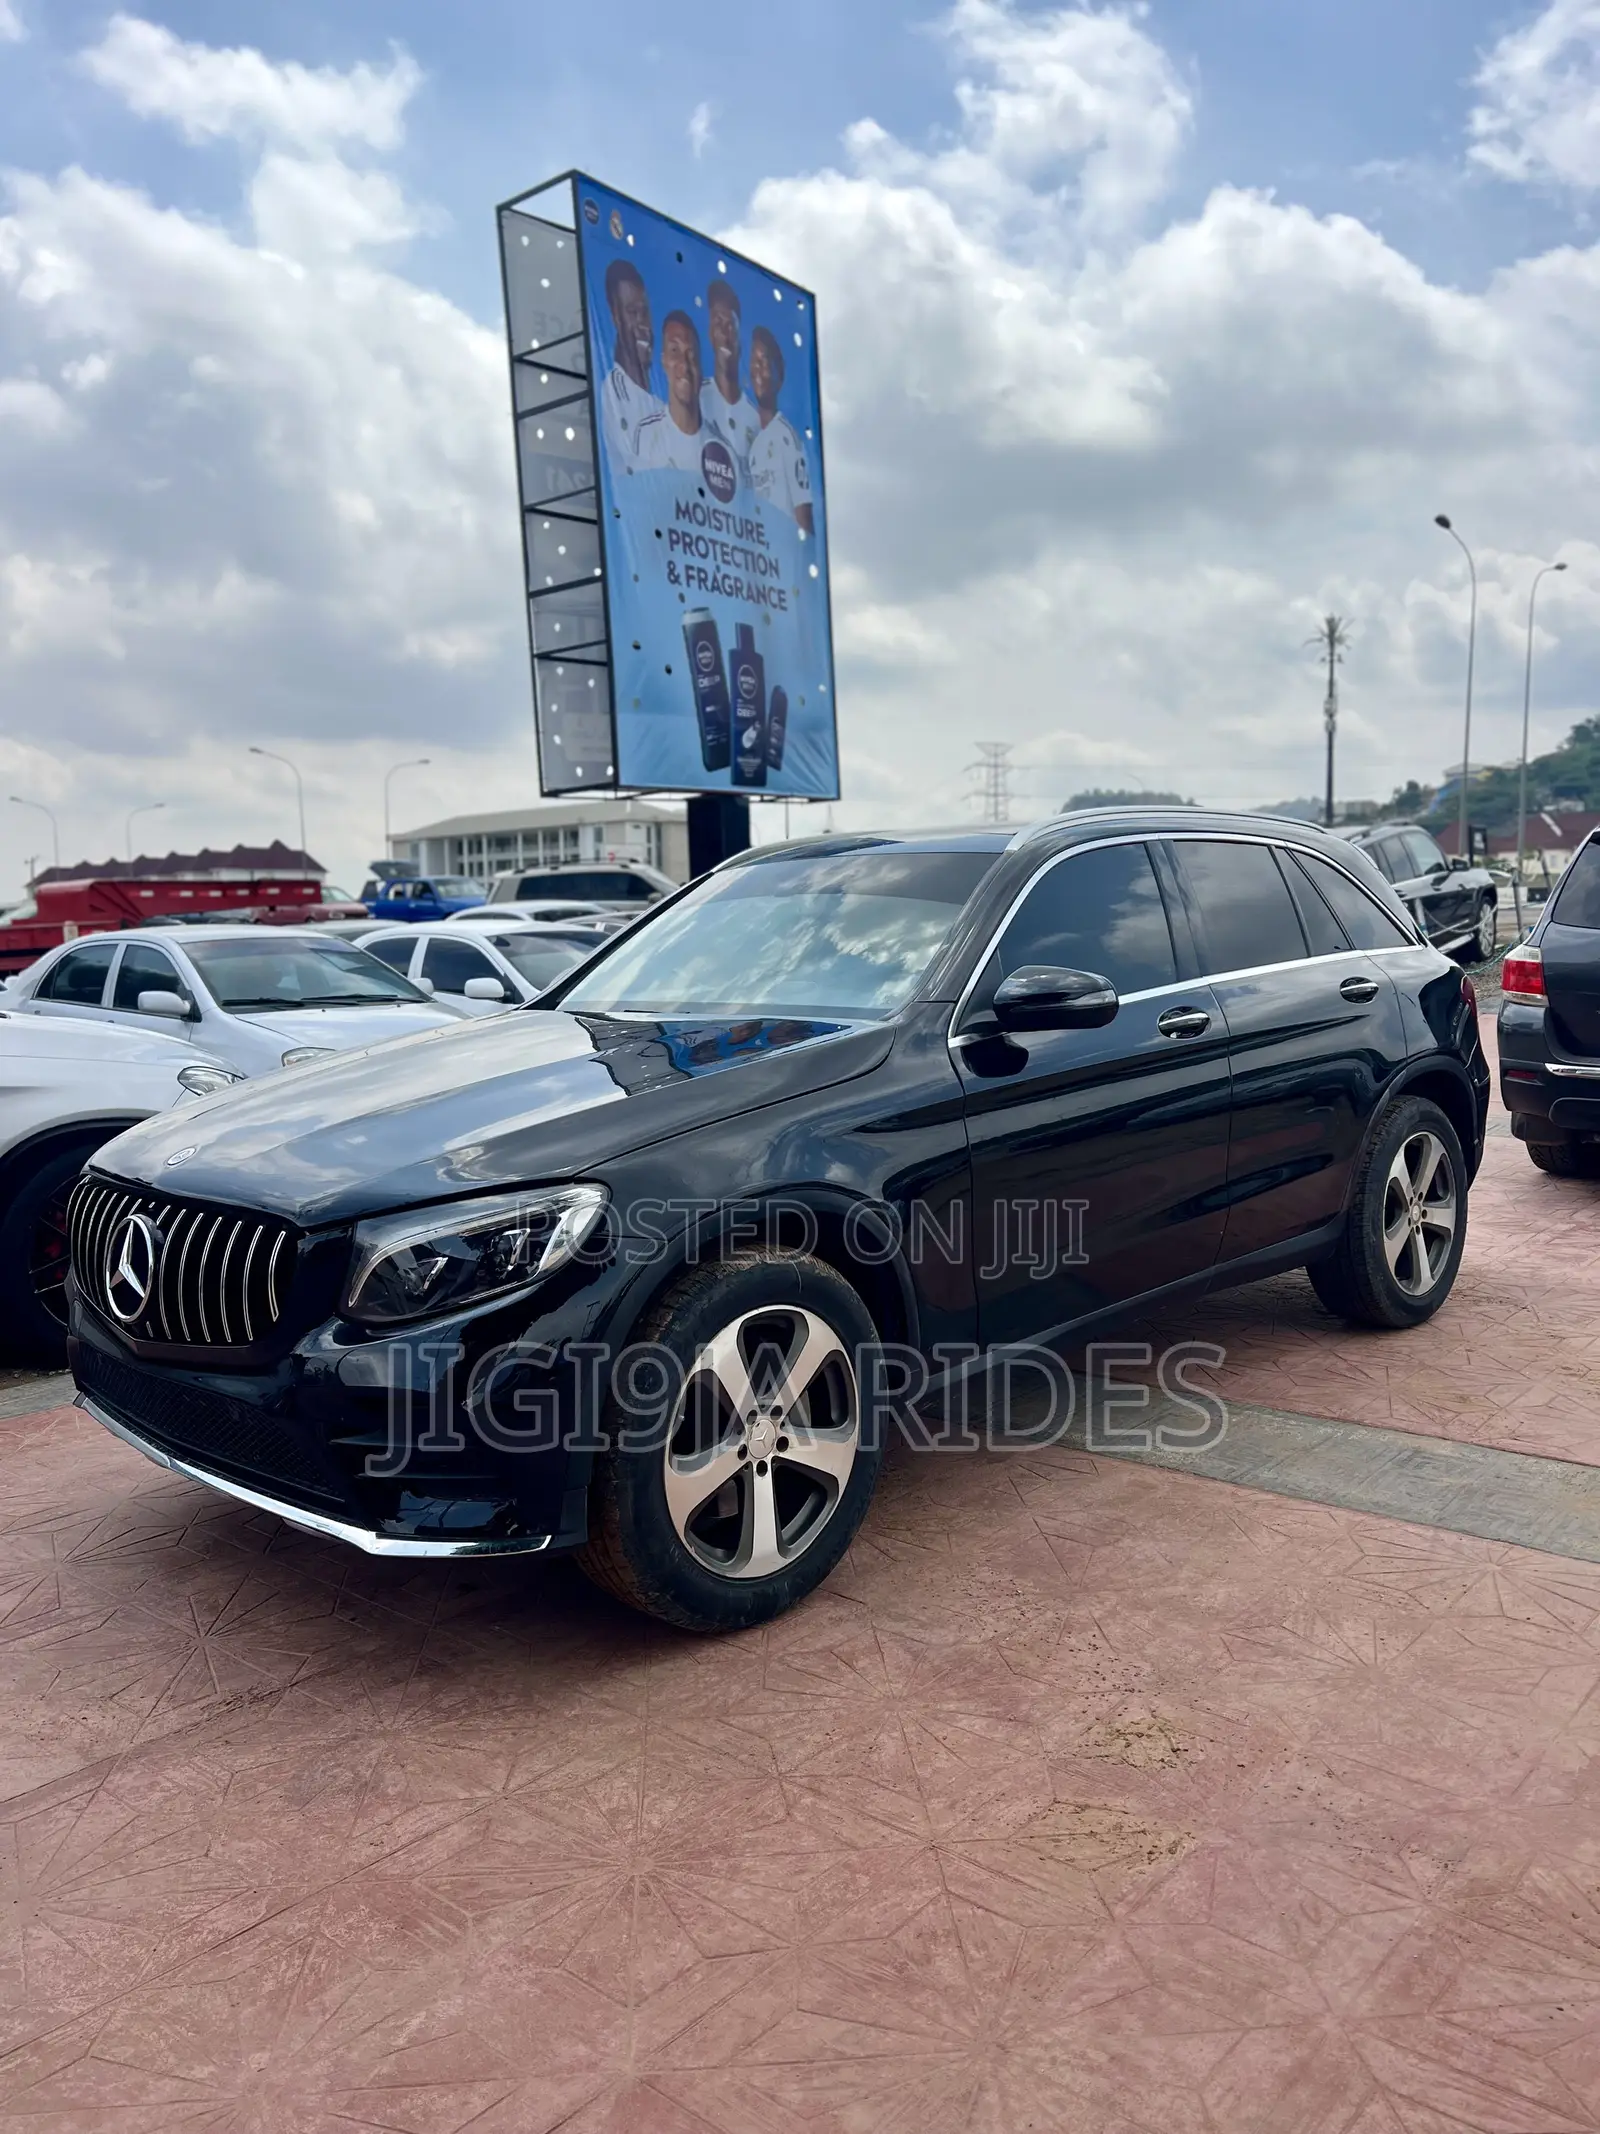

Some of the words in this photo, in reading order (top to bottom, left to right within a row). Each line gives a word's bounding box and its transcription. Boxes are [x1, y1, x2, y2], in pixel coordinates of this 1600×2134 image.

[704, 458, 734, 479] NIVEA
[675, 498, 770, 550] MOISTURE,
[668, 528, 780, 579] PROTECTION
[667, 560, 682, 586] &
[685, 564, 788, 612] FRAGRANCE
